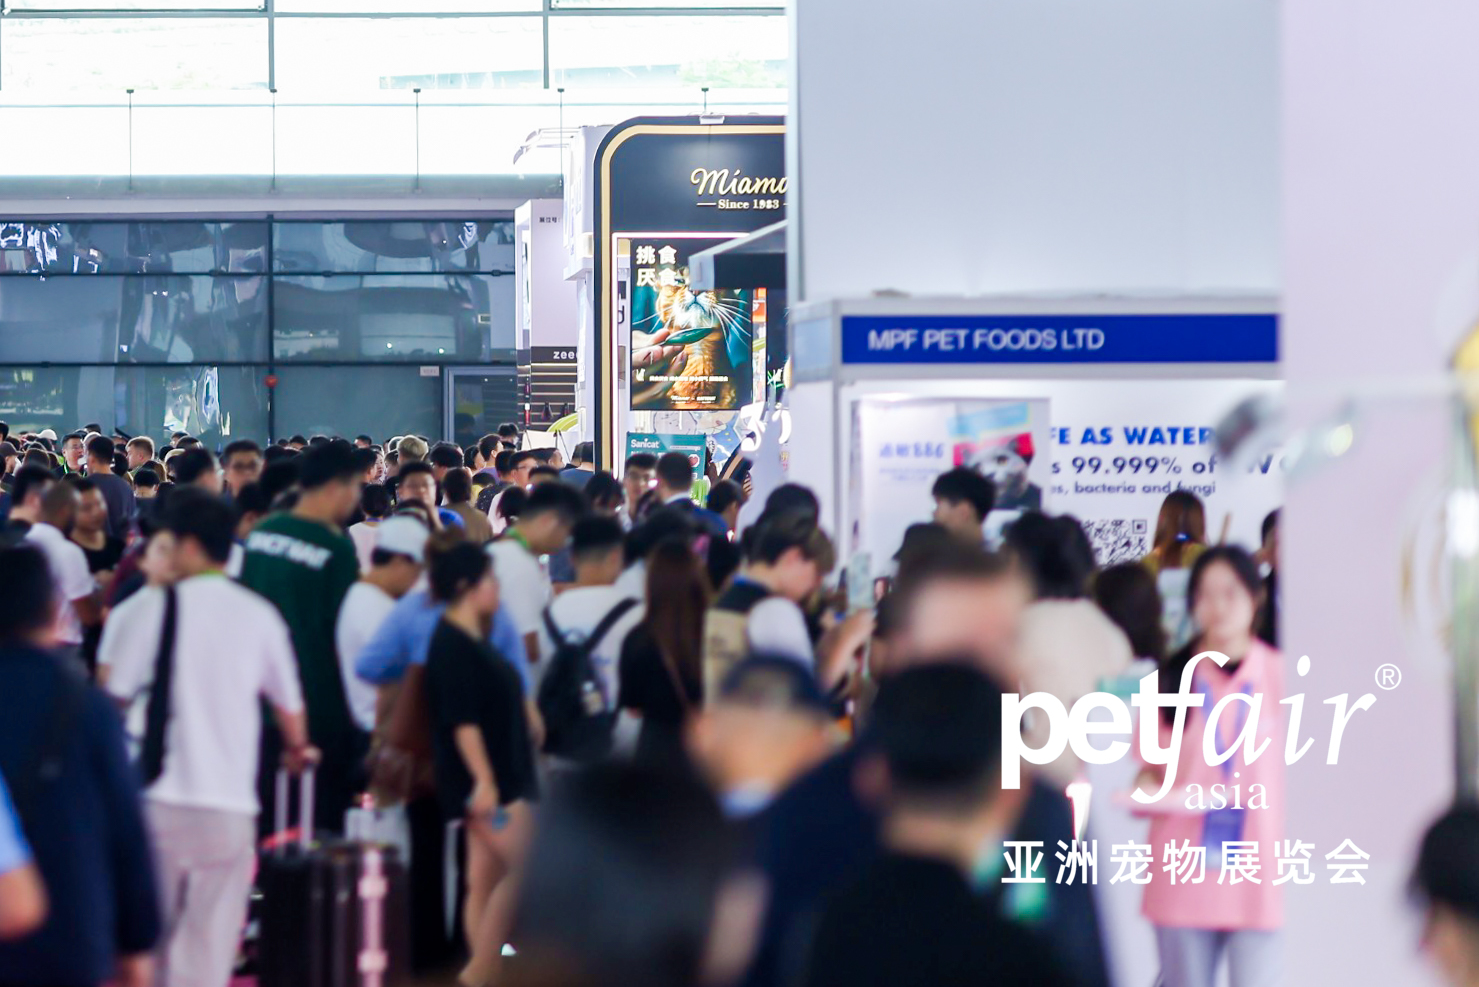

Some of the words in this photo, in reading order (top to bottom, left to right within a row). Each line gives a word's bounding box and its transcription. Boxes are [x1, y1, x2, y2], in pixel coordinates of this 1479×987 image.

[718, 199, 750, 209] Since
[636, 245, 677, 265] 挑食
[636, 268, 677, 287] 厌食
[868, 329, 918, 350] MPF
[922, 329, 969, 350] PET
[973, 329, 1057, 350] FOODS
[1061, 329, 1105, 350] LTD
[630, 438, 660, 449] Sanicat
[1080, 427, 1113, 445] AS
[1071, 456, 1182, 475] 99.999%
[1074, 481, 1136, 494] bacteria
[1141, 481, 1171, 494] and
